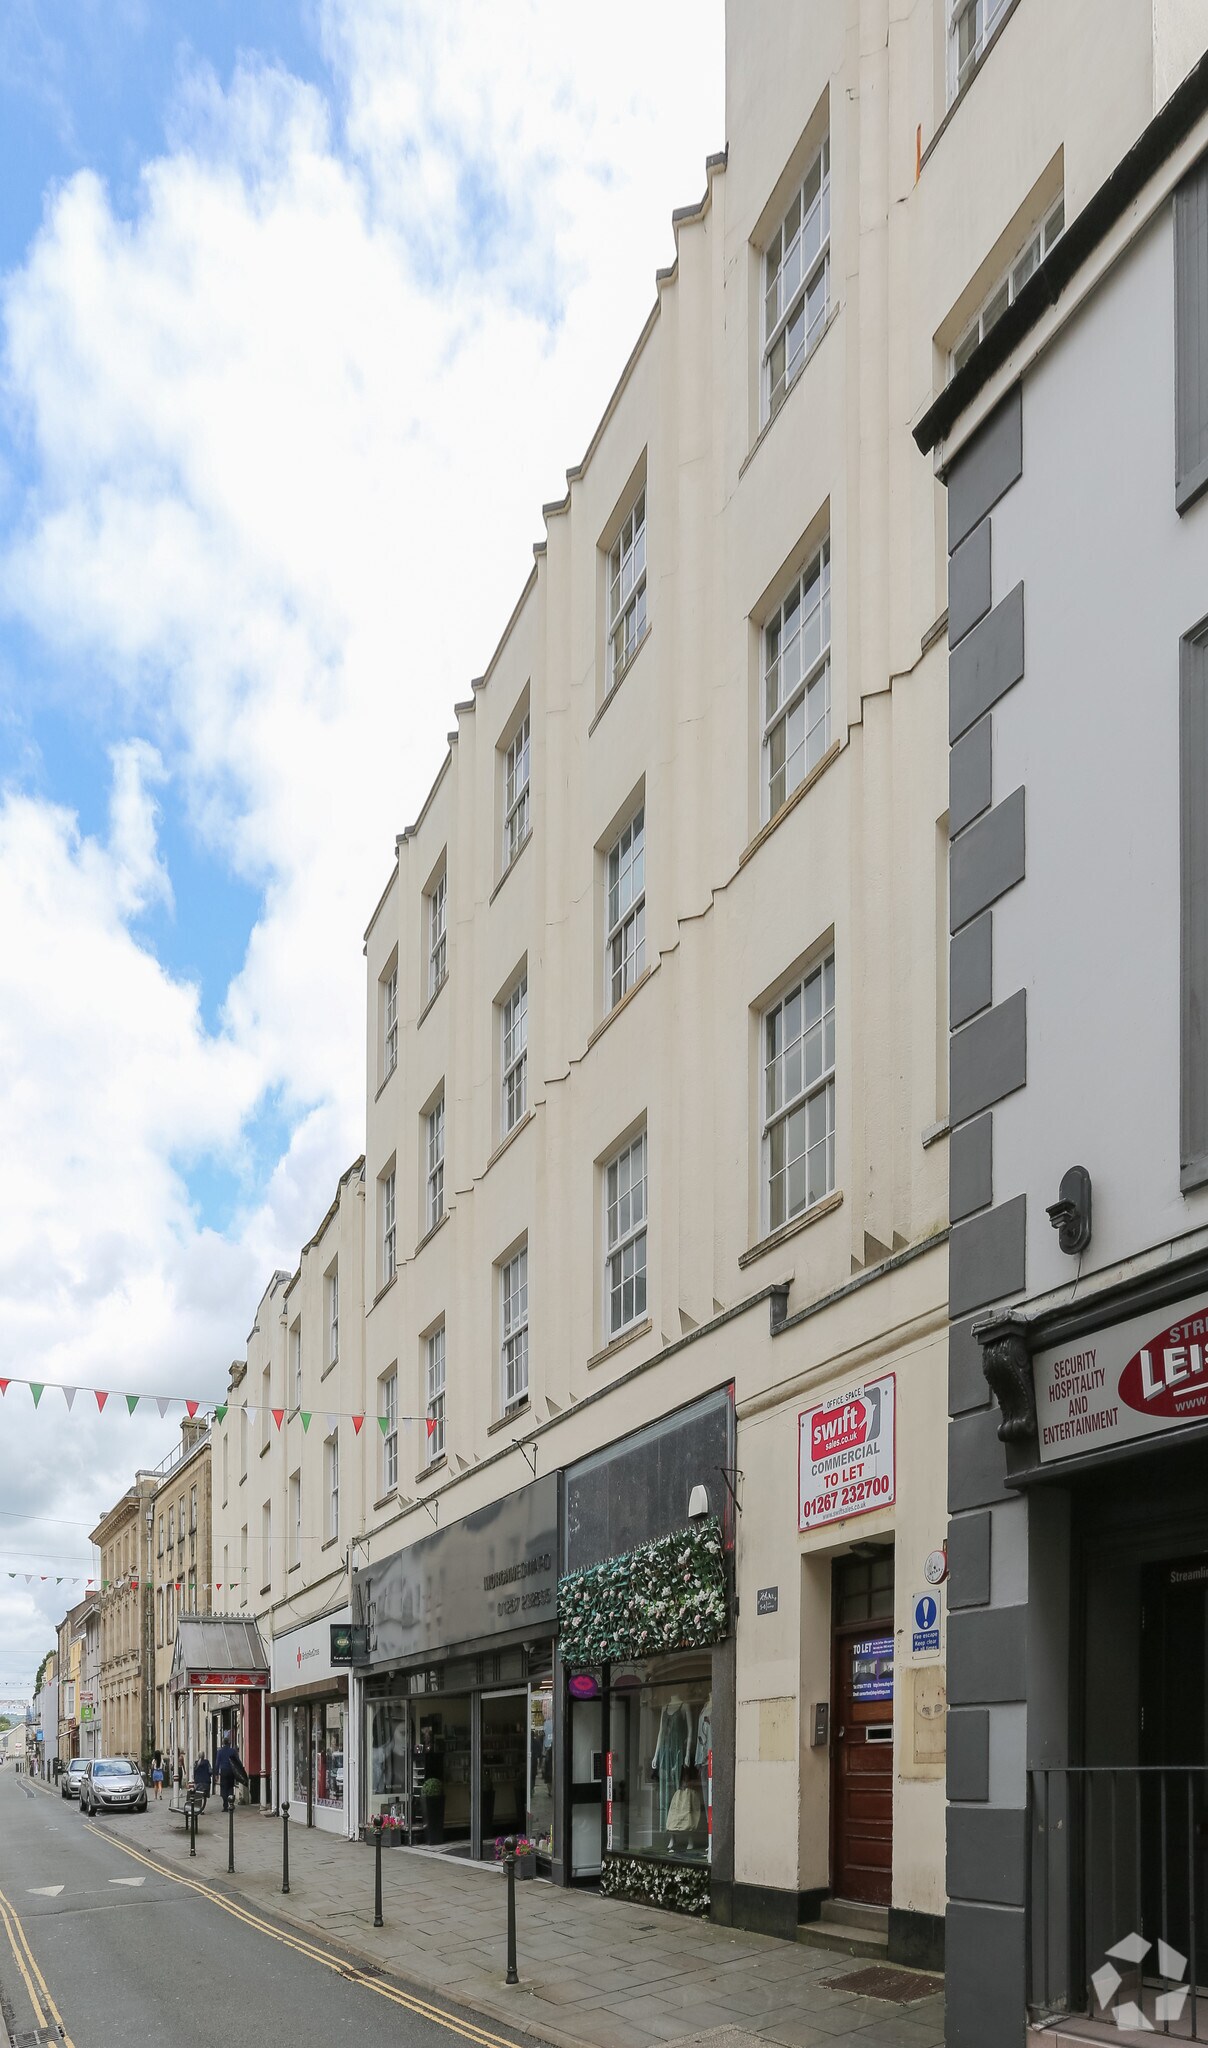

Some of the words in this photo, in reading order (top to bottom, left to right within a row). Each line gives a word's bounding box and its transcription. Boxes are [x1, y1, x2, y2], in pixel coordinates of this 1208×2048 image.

[1169, 1317, 1208, 1343] STR
[1054, 1349, 1097, 1380] SECURITY
[1140, 1343, 1208, 1401] LEI
[826, 1394, 845, 1409] OFFICE
[845, 1387, 862, 1403] SPACE
[1049, 1368, 1105, 1402] HOSPITALITY
[1068, 1395, 1089, 1418] AND
[813, 1405, 858, 1445] swift
[1043, 1407, 1118, 1445] ENTERTAINMENT
[825, 1432, 858, 1451] sales.co.uk
[811, 1442, 880, 1476] COMMERCIAL
[824, 1472, 839, 1489] TO
[842, 1463, 865, 1482] LET
[803, 1491, 838, 1518] 01267
[841, 1475, 889, 1506] 232700
[822, 1502, 867, 1520] www.swiftsales.co.uk
[853, 1644, 861, 1655] TO
[861, 1642, 872, 1654] LET
